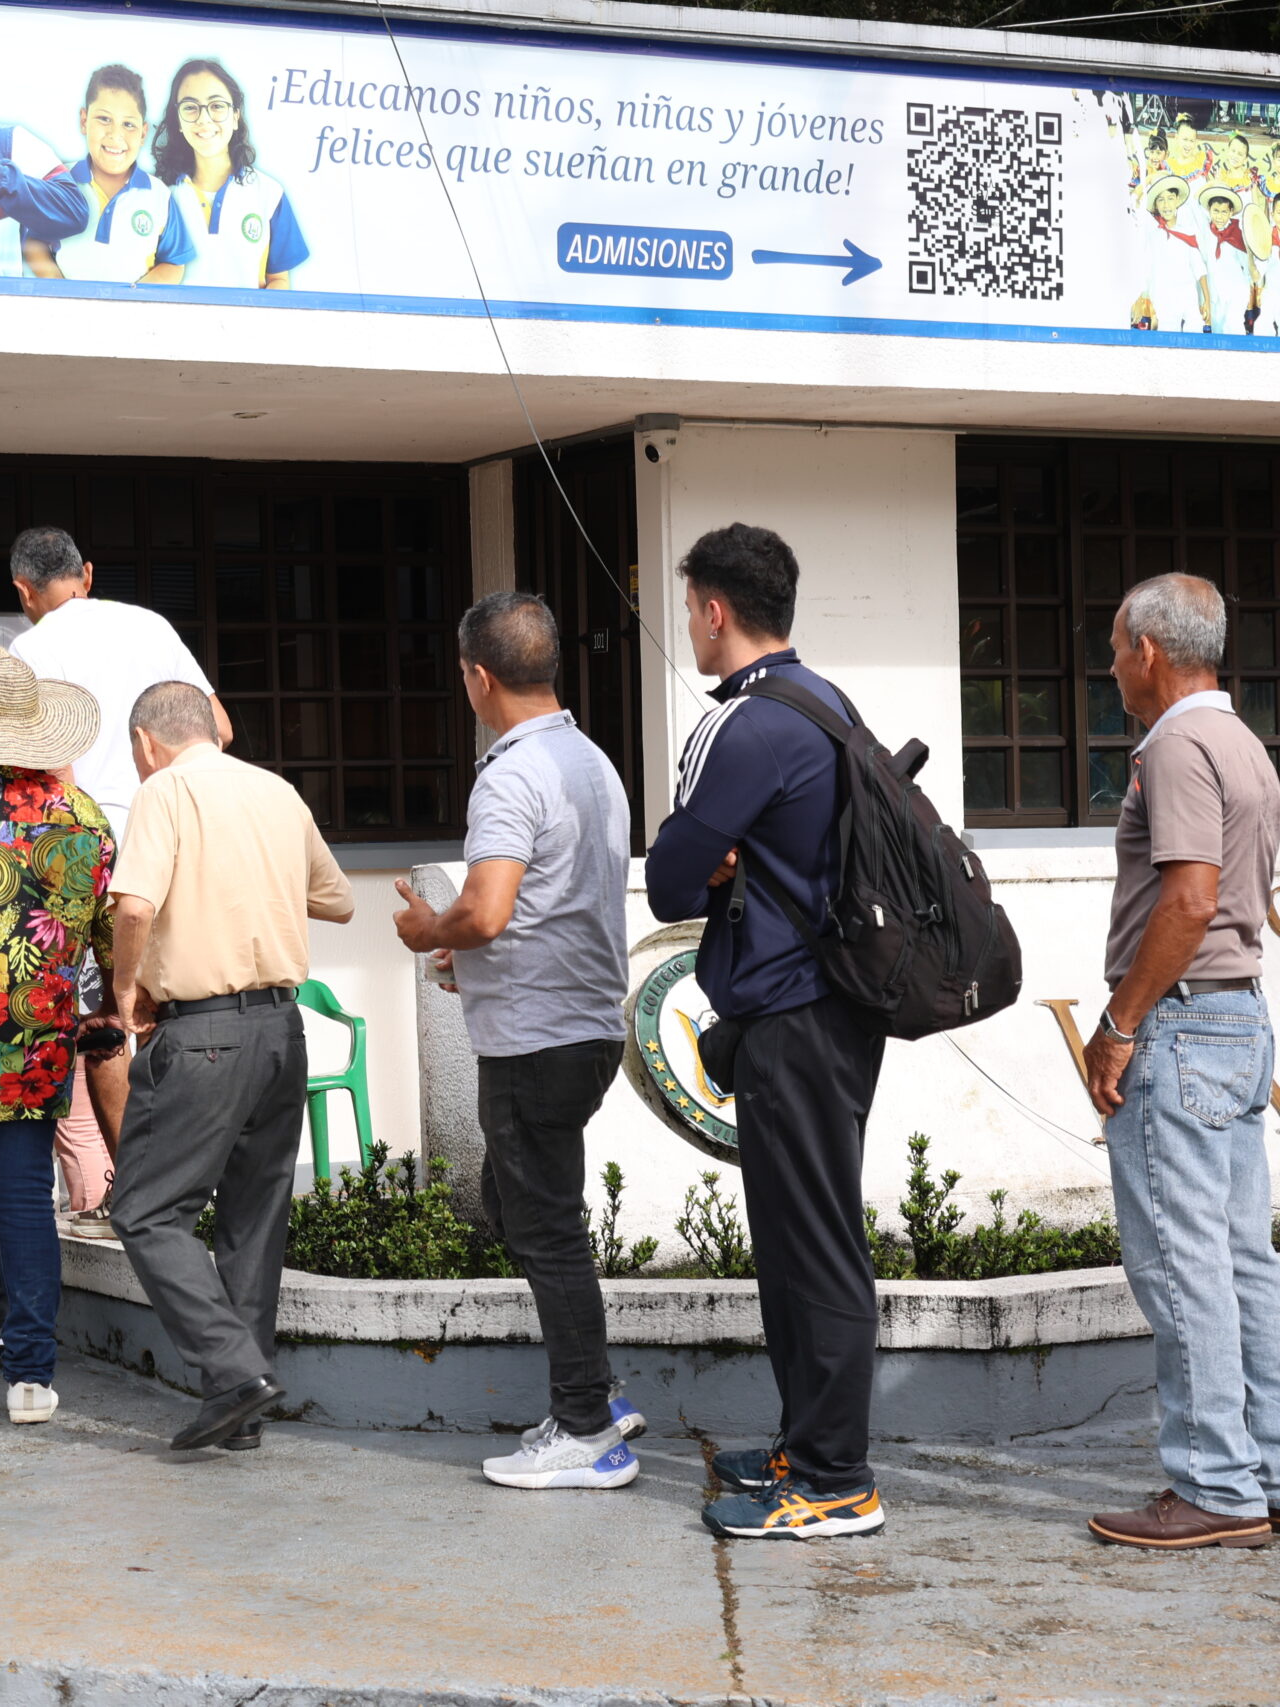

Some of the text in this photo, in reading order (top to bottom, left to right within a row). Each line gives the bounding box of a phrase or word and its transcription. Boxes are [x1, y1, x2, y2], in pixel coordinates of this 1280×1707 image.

[266, 67, 885, 146] ¡Educamos niños, niñas y jóvenes
[309, 126, 854, 198] felices que sueñan en grande!
[565, 232, 726, 271] ADMISIONES
[593, 633, 604, 649] 101
